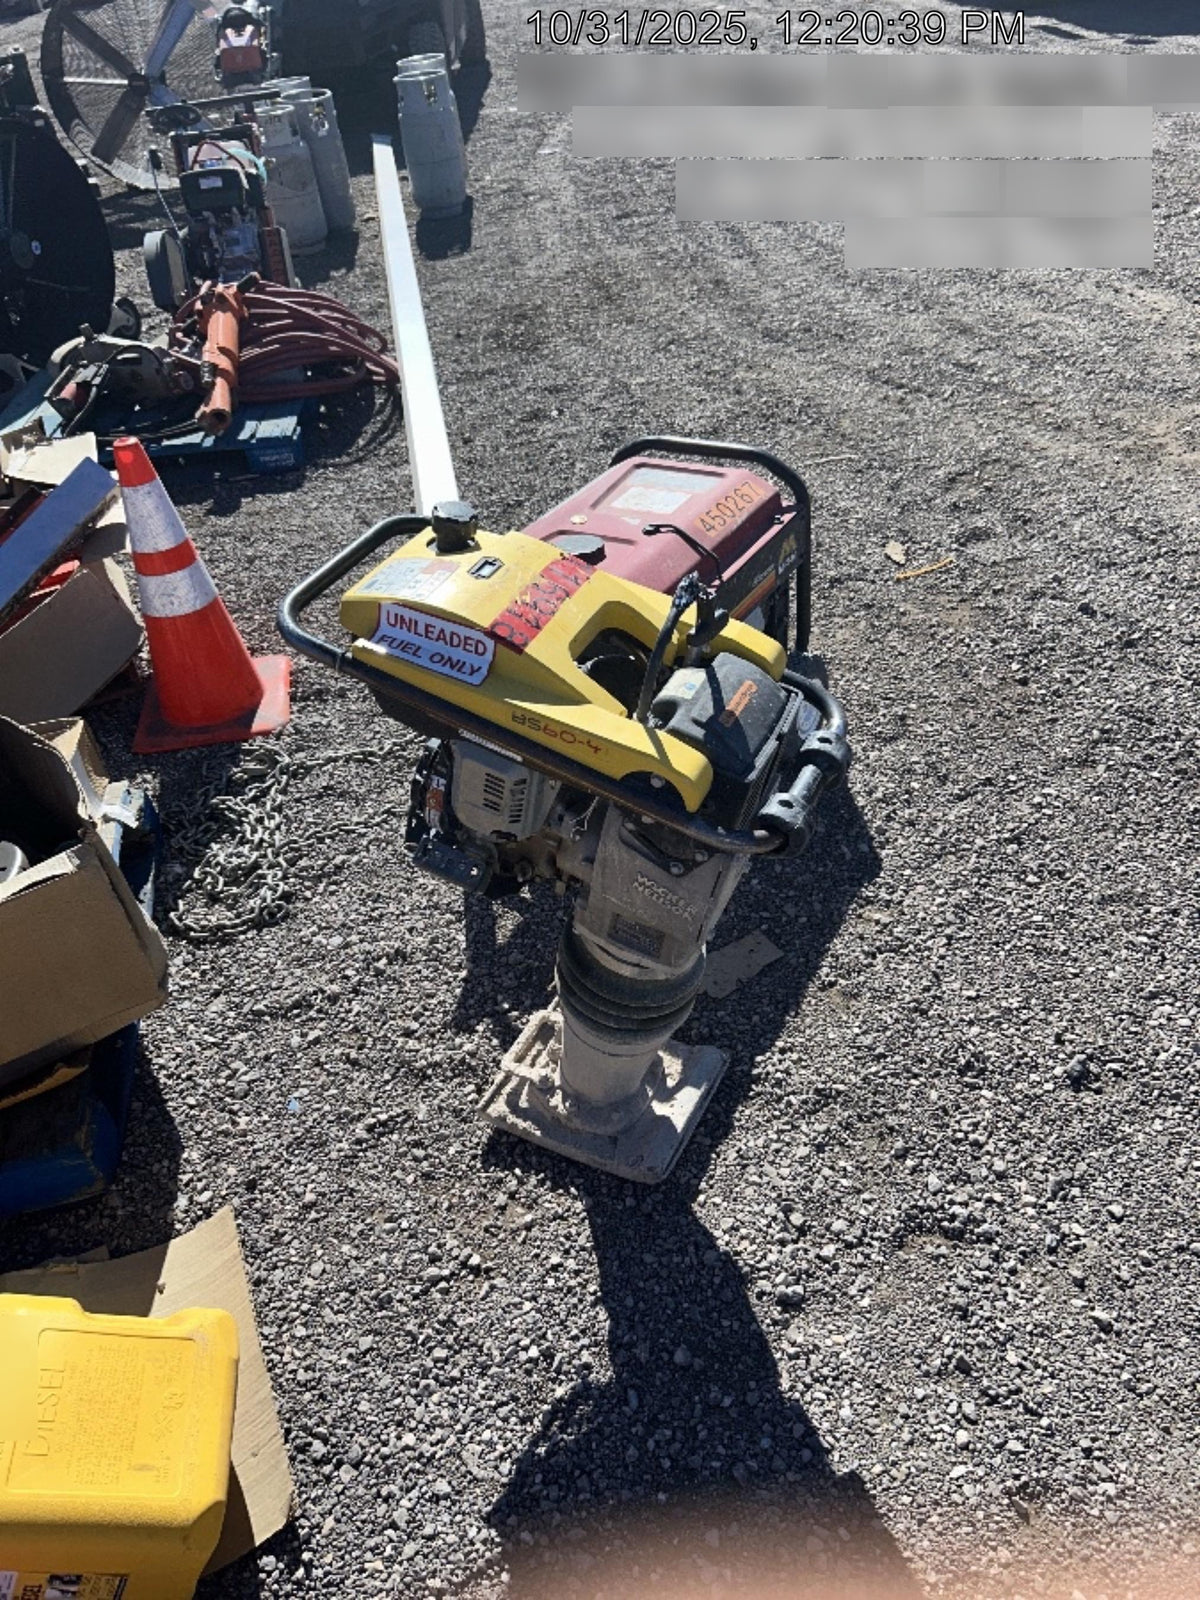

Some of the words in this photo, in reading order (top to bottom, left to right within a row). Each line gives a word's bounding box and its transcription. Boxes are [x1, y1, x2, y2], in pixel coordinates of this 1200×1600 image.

[699, 481, 761, 533] 450267
[376, 633, 423, 659] FUEL
[429, 651, 482, 677] ONLY
[386, 609, 488, 657] UNLEADED
